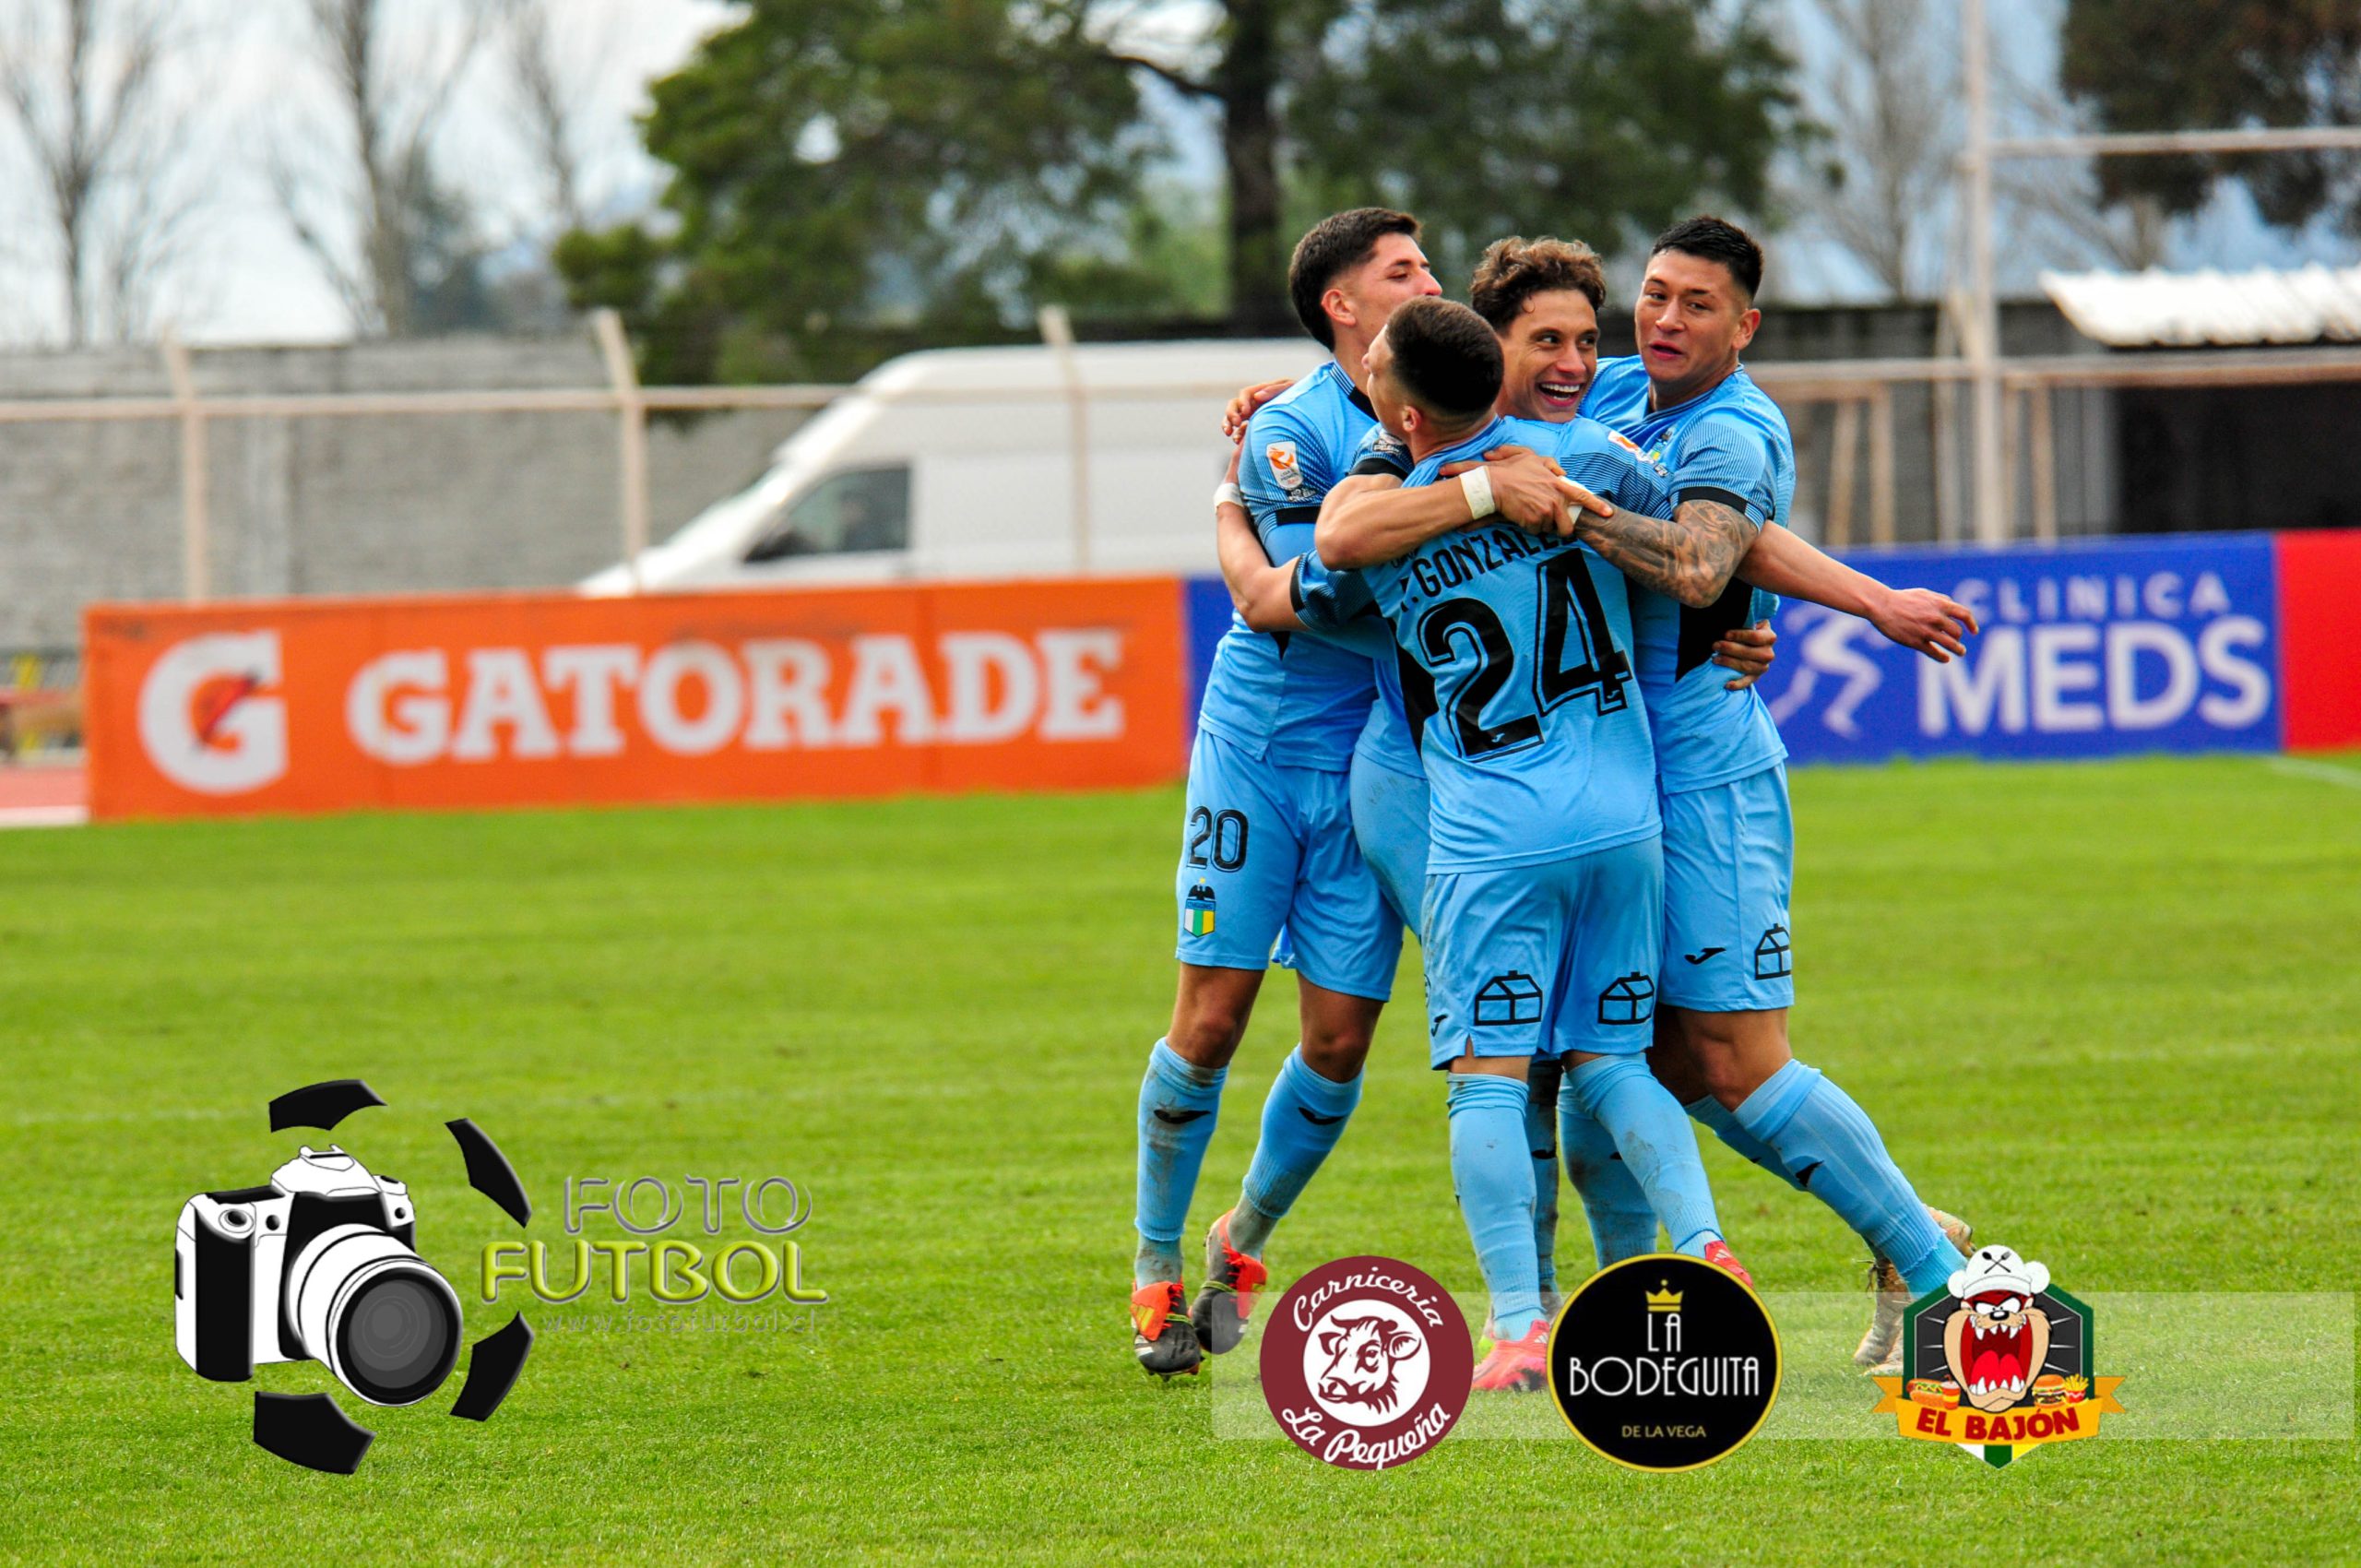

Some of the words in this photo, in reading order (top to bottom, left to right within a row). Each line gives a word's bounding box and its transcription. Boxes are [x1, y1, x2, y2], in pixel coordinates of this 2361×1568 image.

[347, 626, 1126, 767] GATORADE
[1417, 547, 1634, 764] 24
[1917, 614, 2272, 737] MEDS
[1187, 805, 1249, 873] 20
